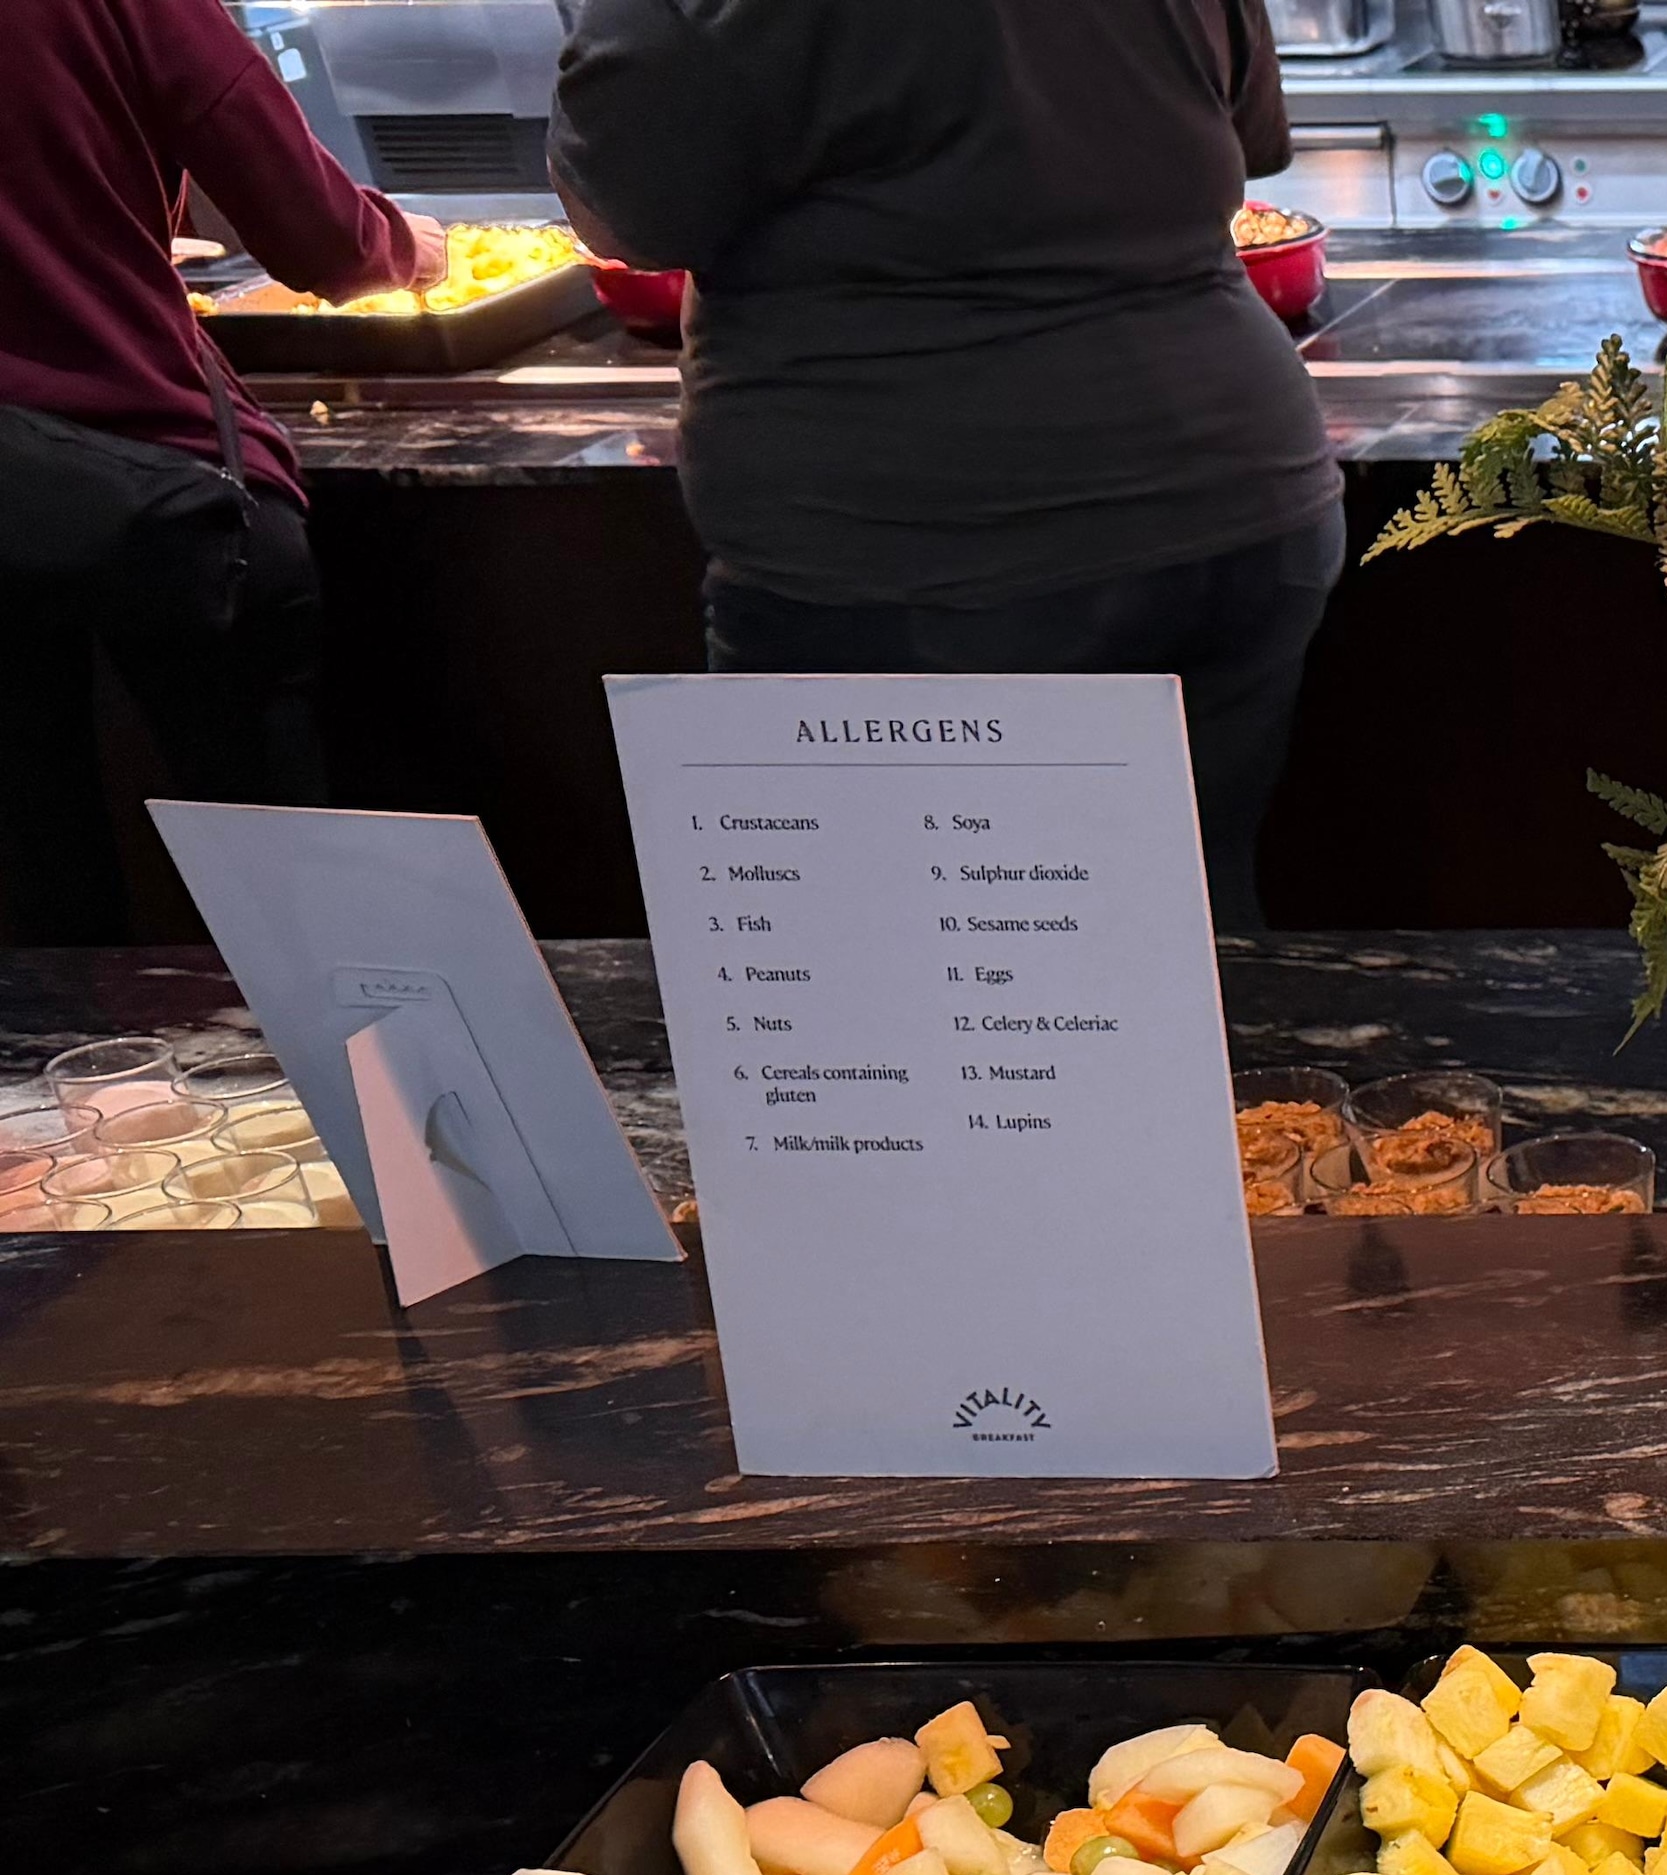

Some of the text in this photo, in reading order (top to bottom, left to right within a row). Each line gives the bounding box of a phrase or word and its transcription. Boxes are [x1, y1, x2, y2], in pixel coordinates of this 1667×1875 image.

[797, 719, 1002, 743] ALLERGENS
[692, 814, 819, 831] 1. Crustaceans
[924, 815, 990, 834] 8. Soya
[700, 865, 800, 881] 2. Molluscs
[931, 865, 1089, 885] 9. Sulphur dioxide
[709, 915, 771, 932] 3. Fish
[940, 915, 1078, 932] 10. Sesame seeds
[718, 966, 811, 982] 4. Peanuts
[947, 966, 1014, 985] 11. Eggs
[727, 1016, 792, 1031] 5. Nuts
[954, 1015, 1119, 1034] 12. Celery & Celeriac
[734, 1065, 909, 1084] 6. Cereals containing
[961, 1065, 1056, 1080] 13. Mustard
[766, 1087, 816, 1106] gluten
[969, 1113, 1051, 1132] 14. Lupins
[745, 1135, 924, 1154] 7. Milk/milk products
[953, 1387, 1051, 1428] VITALITY
